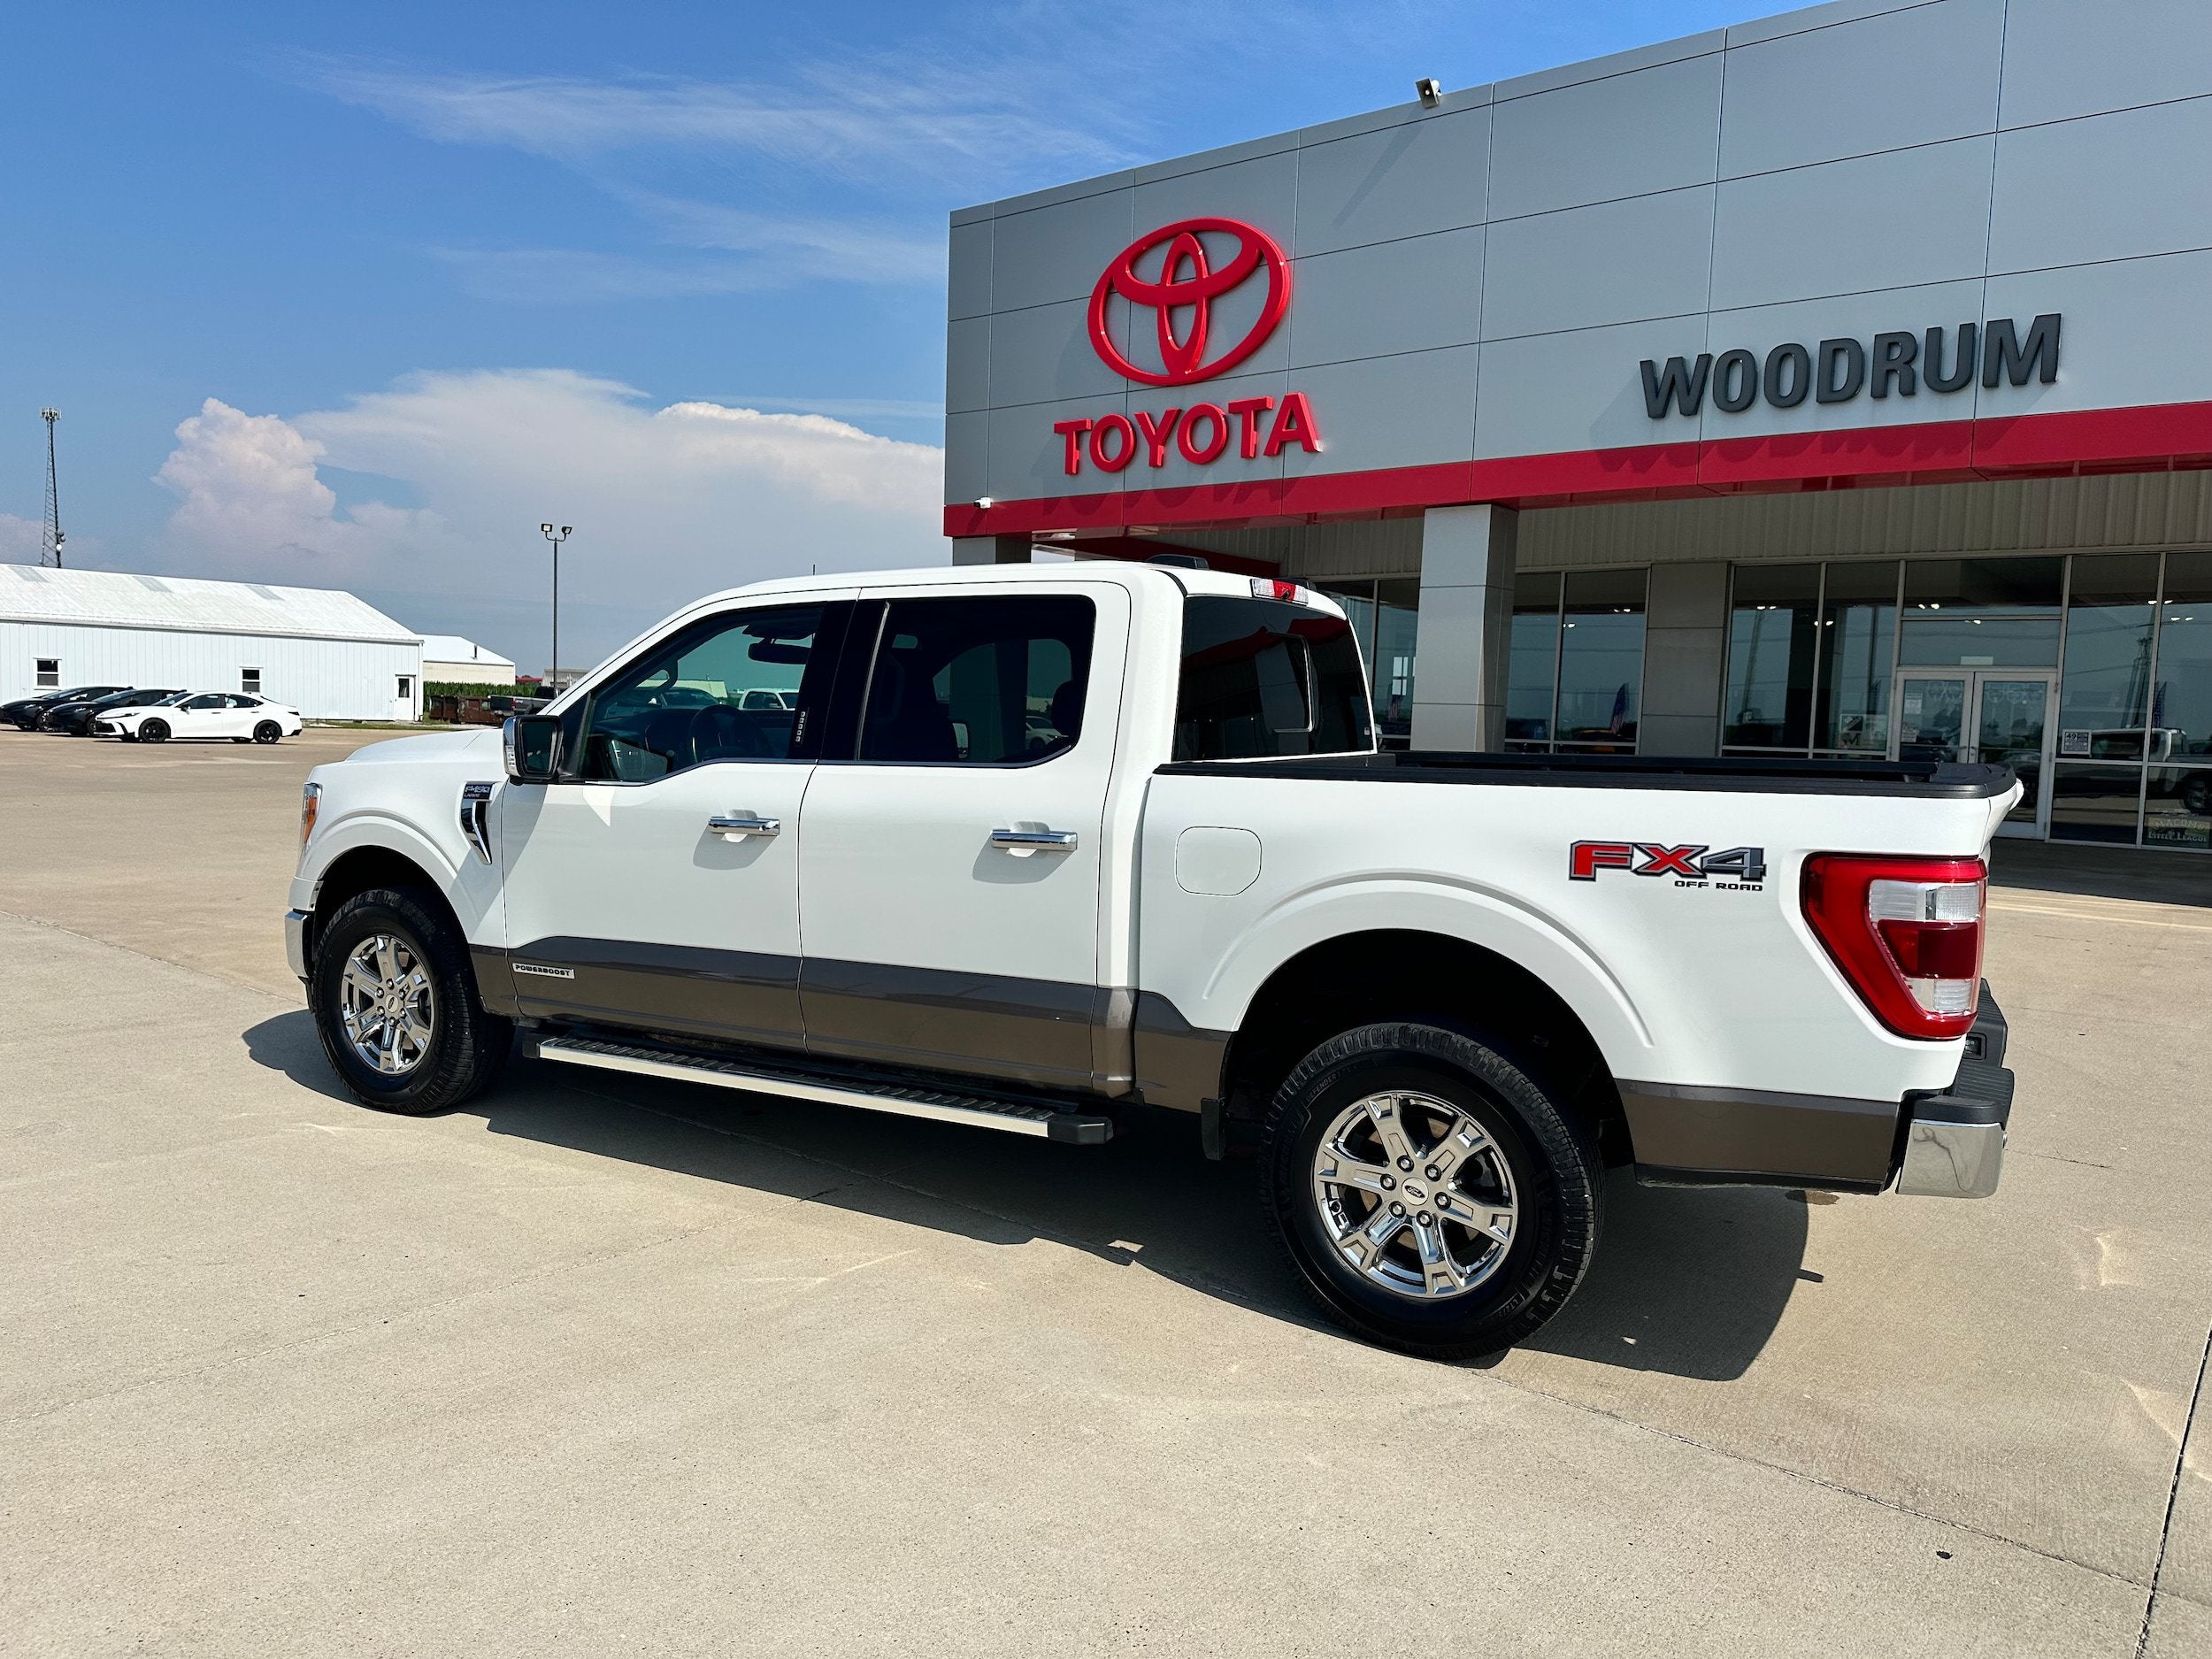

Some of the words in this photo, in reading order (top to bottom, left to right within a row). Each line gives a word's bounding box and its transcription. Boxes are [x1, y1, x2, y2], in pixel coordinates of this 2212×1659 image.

[1640, 313, 2062, 419] WOODRUM
[1054, 392, 1322, 475] TOYOTA
[1569, 840, 1767, 882] FX4
[1716, 882, 1763, 892] ROAD
[515, 964, 571, 977] POWERBOOST
